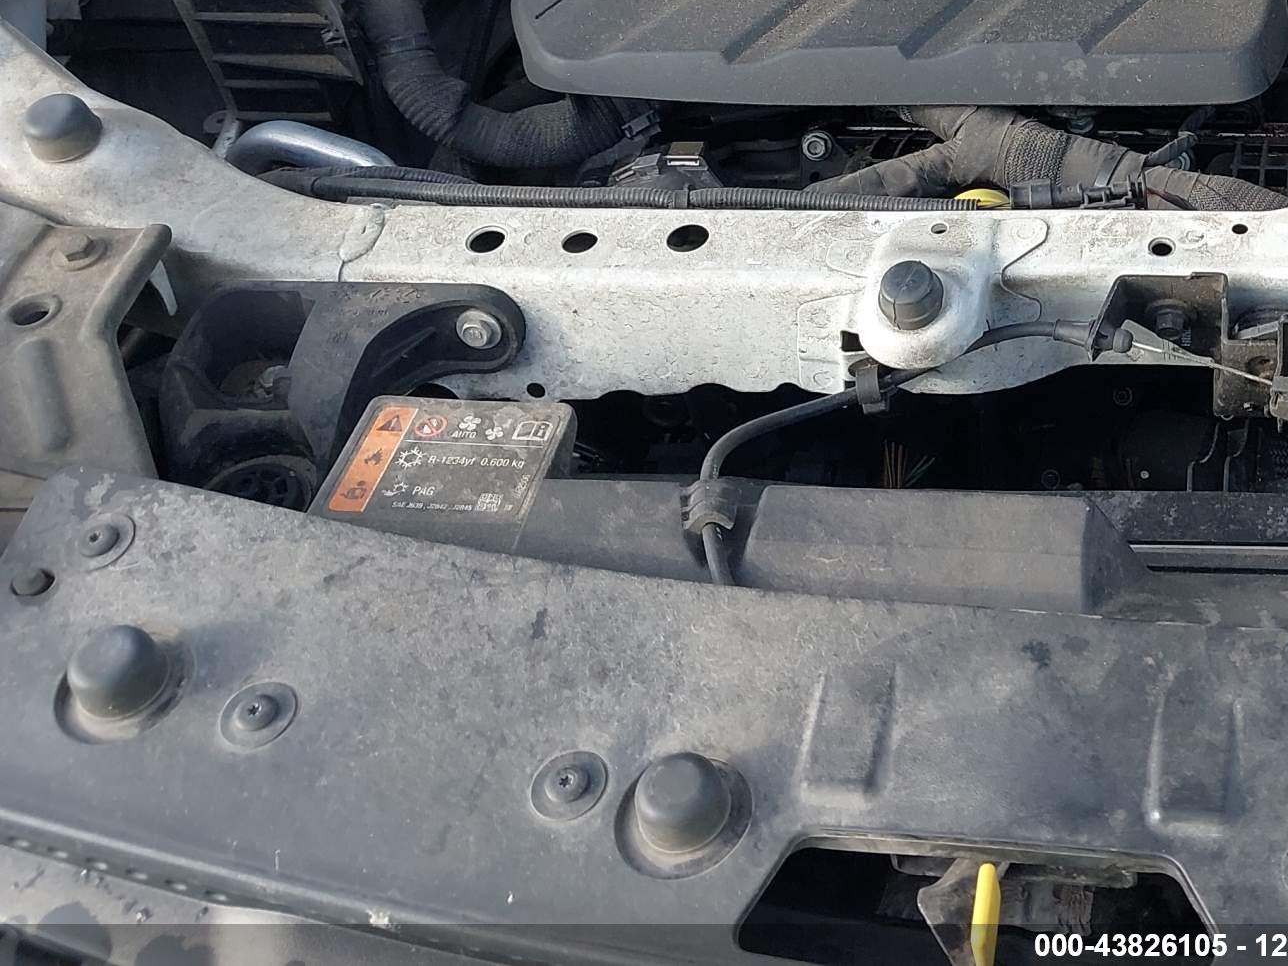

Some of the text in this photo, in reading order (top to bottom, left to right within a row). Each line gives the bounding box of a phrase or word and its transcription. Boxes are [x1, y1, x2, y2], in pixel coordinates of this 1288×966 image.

[451, 430, 478, 439] AUTO
[427, 455, 525, 469] R-1234yf 0.600 kg
[411, 485, 436, 496] PAG
